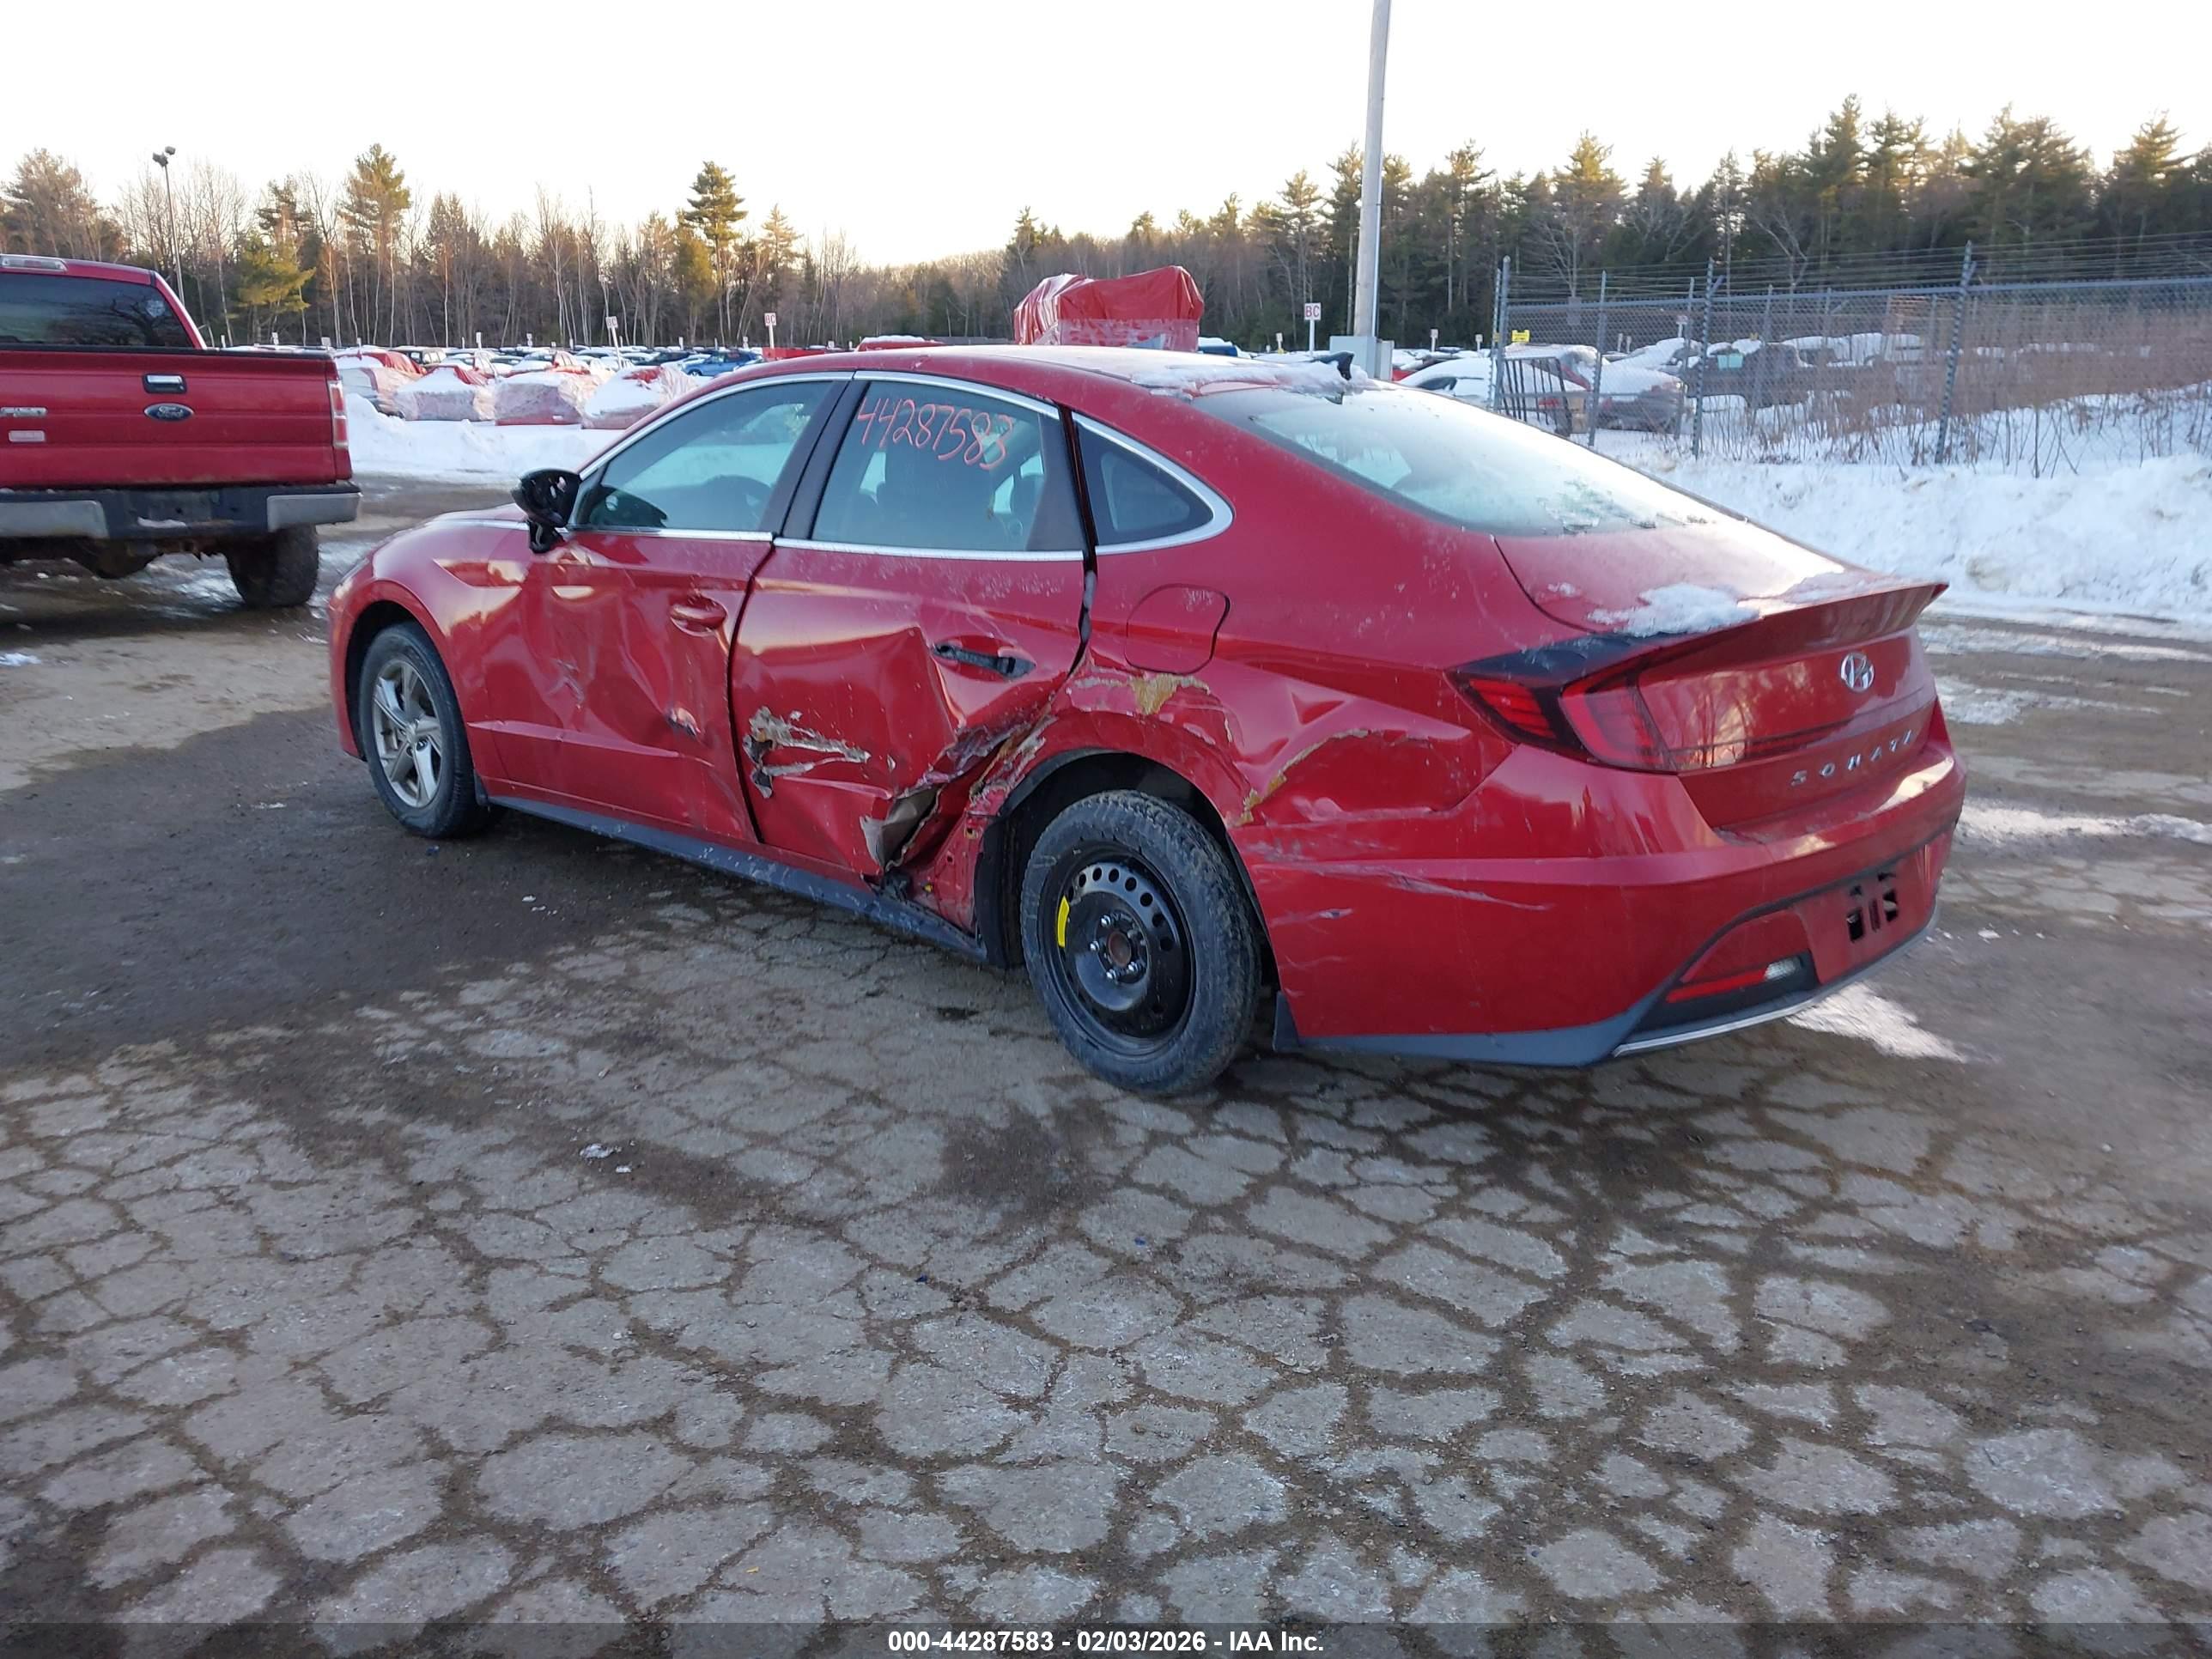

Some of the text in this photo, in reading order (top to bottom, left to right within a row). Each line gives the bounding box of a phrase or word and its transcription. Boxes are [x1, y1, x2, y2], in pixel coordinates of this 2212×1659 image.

[1304, 305, 1320, 318] BC
[156, 404, 185, 420] Ford
[857, 398, 1014, 471] 44287583
[1790, 729, 1912, 787] SONATA
